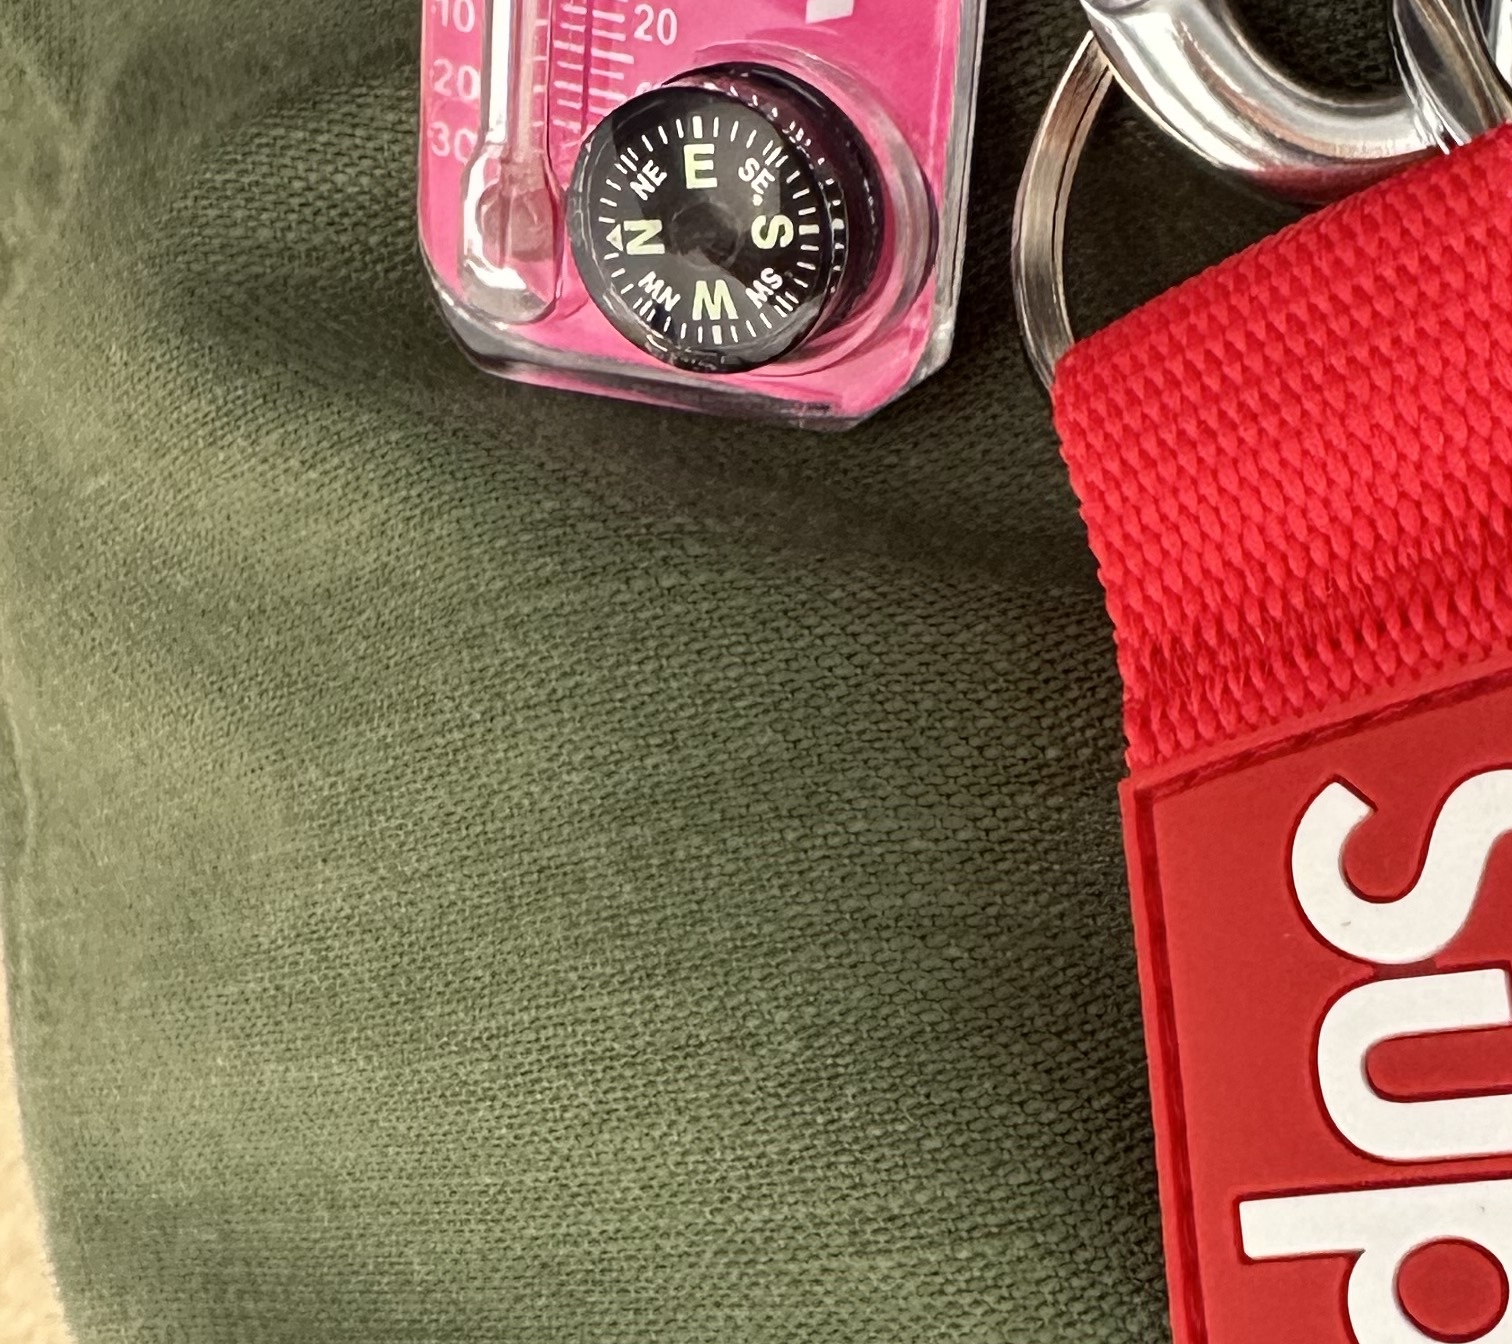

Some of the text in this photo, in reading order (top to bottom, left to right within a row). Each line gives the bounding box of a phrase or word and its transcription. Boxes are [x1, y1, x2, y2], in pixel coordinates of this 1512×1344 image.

[633, 3, 679, 46] 20
[630, 159, 668, 201] NE
[683, 143, 718, 190] E
[623, 218, 666, 256] N
[751, 214, 794, 250] S
[637, 270, 682, 312] NW
[692, 279, 740, 321] W
[745, 267, 783, 310] SW
